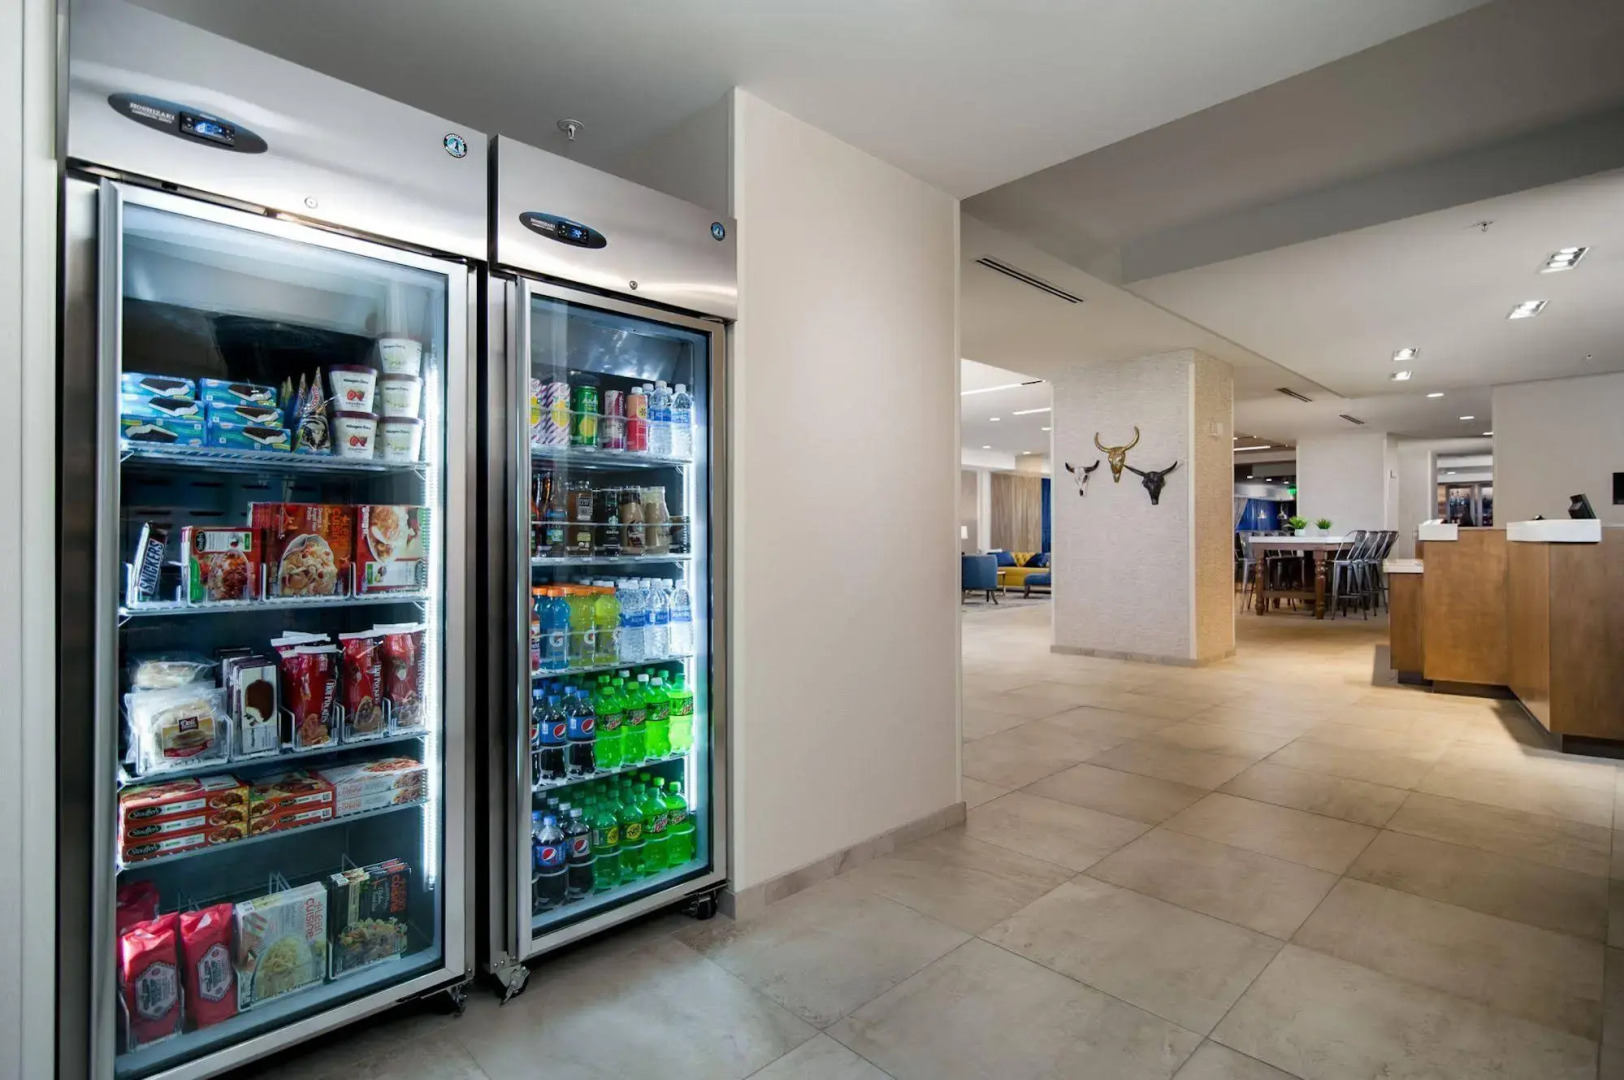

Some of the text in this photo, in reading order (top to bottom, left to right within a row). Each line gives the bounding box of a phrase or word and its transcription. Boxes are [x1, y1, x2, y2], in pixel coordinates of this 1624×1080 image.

[130, 102, 175, 120] HOSHIZAKI
[140, 540, 164, 592] SNICKERS
[133, 807, 160, 817] Stouffer's
[133, 825, 160, 835] Stouffer's
[131, 843, 158, 855] Stouffer's
